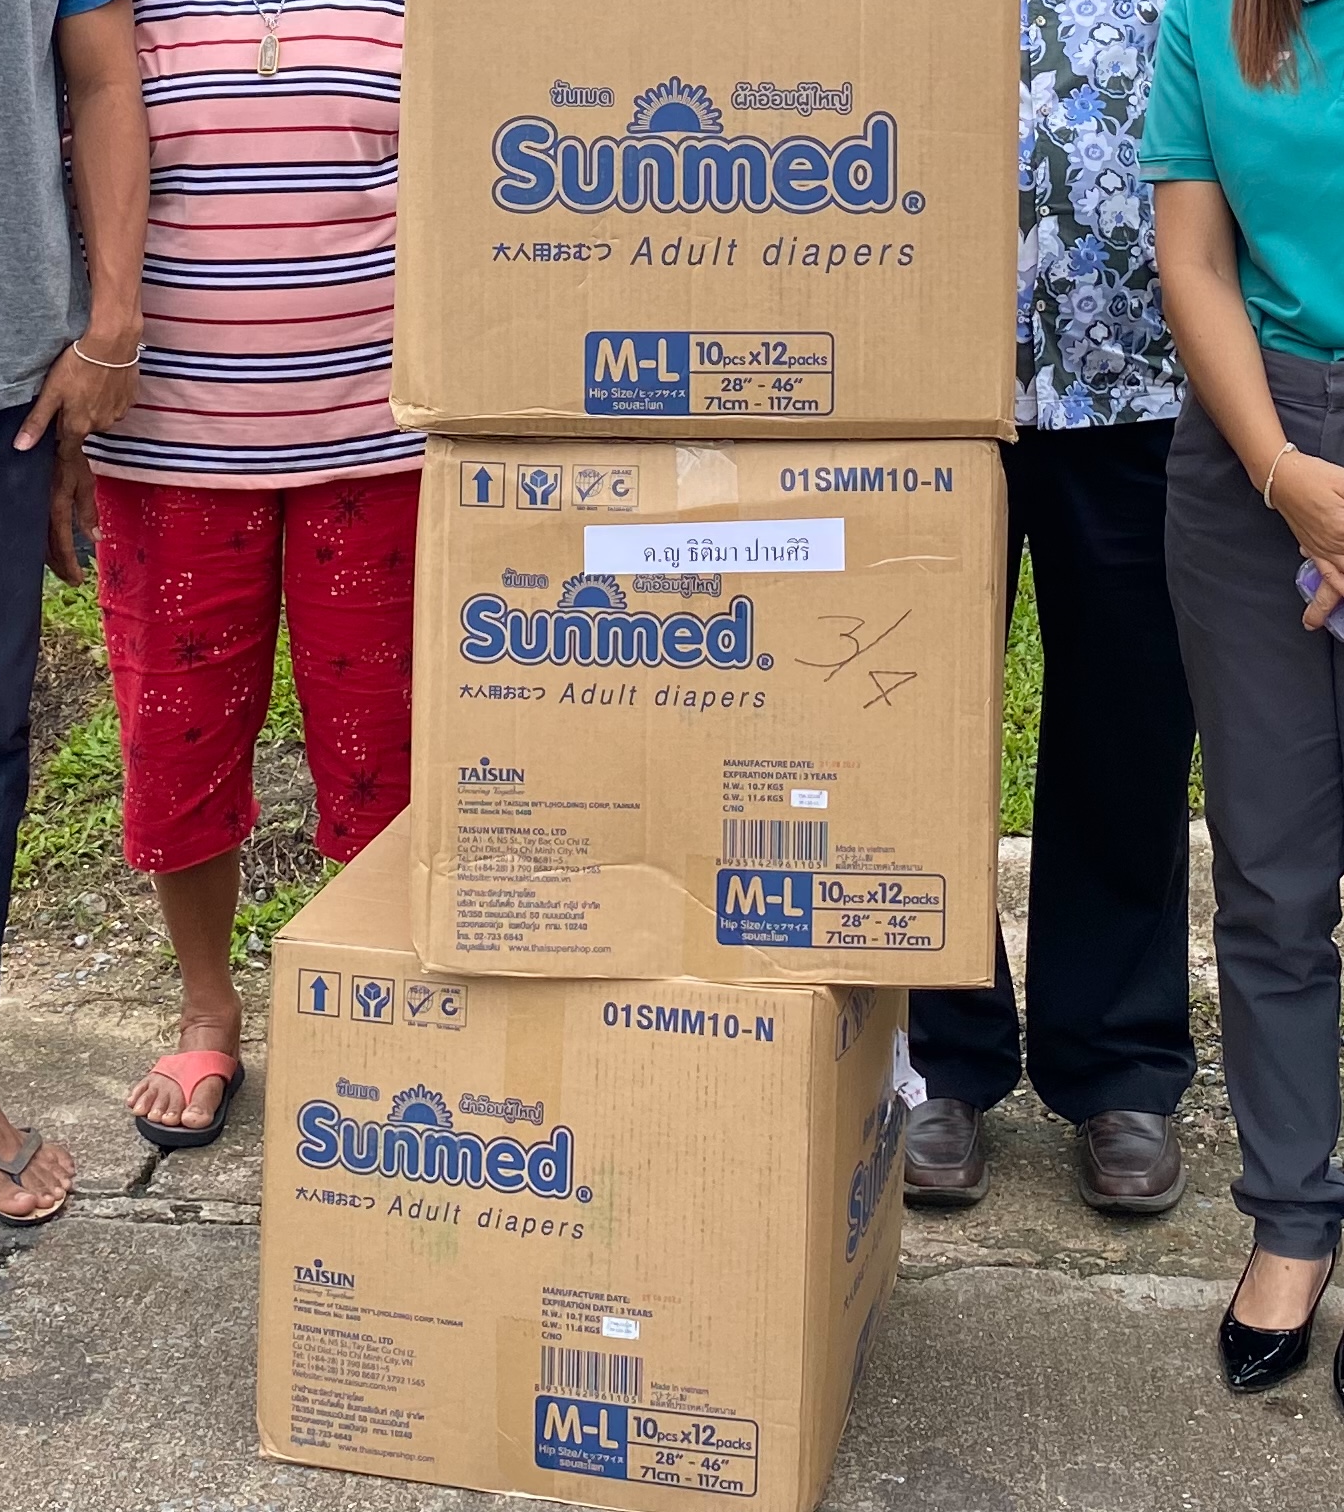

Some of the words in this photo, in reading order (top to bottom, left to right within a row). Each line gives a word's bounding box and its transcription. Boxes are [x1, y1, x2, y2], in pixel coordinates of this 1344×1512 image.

[550, 80, 614, 107] ซันเมด
[731, 81, 853, 117] ผ้าอ้อมผู้ใหญ่
[492, 112, 898, 215] Sunmed
[492, 242, 612, 263] 大人用おむつ
[630, 236, 738, 266] Adult
[762, 236, 915, 274] diapers
[594, 338, 680, 382] M-L
[589, 388, 608, 399] Hip
[612, 397, 663, 410] รอบสะโพก
[705, 396, 748, 411] 71cm
[768, 396, 818, 411] 117cm
[780, 467, 953, 492] 01SMM10-N
[460, 593, 754, 670] Sunmed
[460, 685, 545, 700] 大人用おむつ
[559, 683, 638, 706] Adult
[654, 684, 766, 712] diapers
[458, 757, 525, 782] TAISUN
[723, 759, 788, 769] MANUFACTURE
[790, 760, 814, 769] DATE:
[723, 771, 774, 780] EXPIRATION
[776, 772, 797, 780] DATE
[811, 773, 837, 781] YEARS
[747, 783, 765, 791] 10.7
[767, 783, 784, 791] KGS
[747, 794, 765, 802] 11.6
[767, 794, 784, 802] KGS
[458, 826, 490, 834] TAISUN
[491, 827, 530, 835] VIETNAM
[551, 828, 567, 836] LTD
[535, 846, 555, 854] Minh
[576, 847, 587, 855] VN
[725, 874, 804, 917] M-L
[509, 944, 611, 954] www.thaisupershop.com
[825, 931, 866, 945] 71cm
[884, 932, 931, 946] 117cm
[603, 1002, 774, 1042] 01SMM10-N
[296, 1100, 573, 1199] Sunmed
[295, 1187, 376, 1210] 大人用おむつ
[388, 1195, 462, 1224] Adult
[477, 1207, 584, 1239] diapers
[294, 1259, 355, 1288] TAISUN
[542, 1286, 605, 1301] MANUFACTURE
[542, 1298, 591, 1311] EXPIRATION
[593, 1304, 614, 1314] DATE
[627, 1308, 653, 1318] YEARS
[585, 1315, 601, 1323] KGS
[293, 1323, 321, 1335] TAISUN
[323, 1327, 360, 1341] VIETNAM
[379, 1336, 393, 1345] LTD
[544, 1402, 619, 1449] M-L
[640, 1465, 680, 1484] 71cm
[697, 1473, 743, 1492] 117cm
